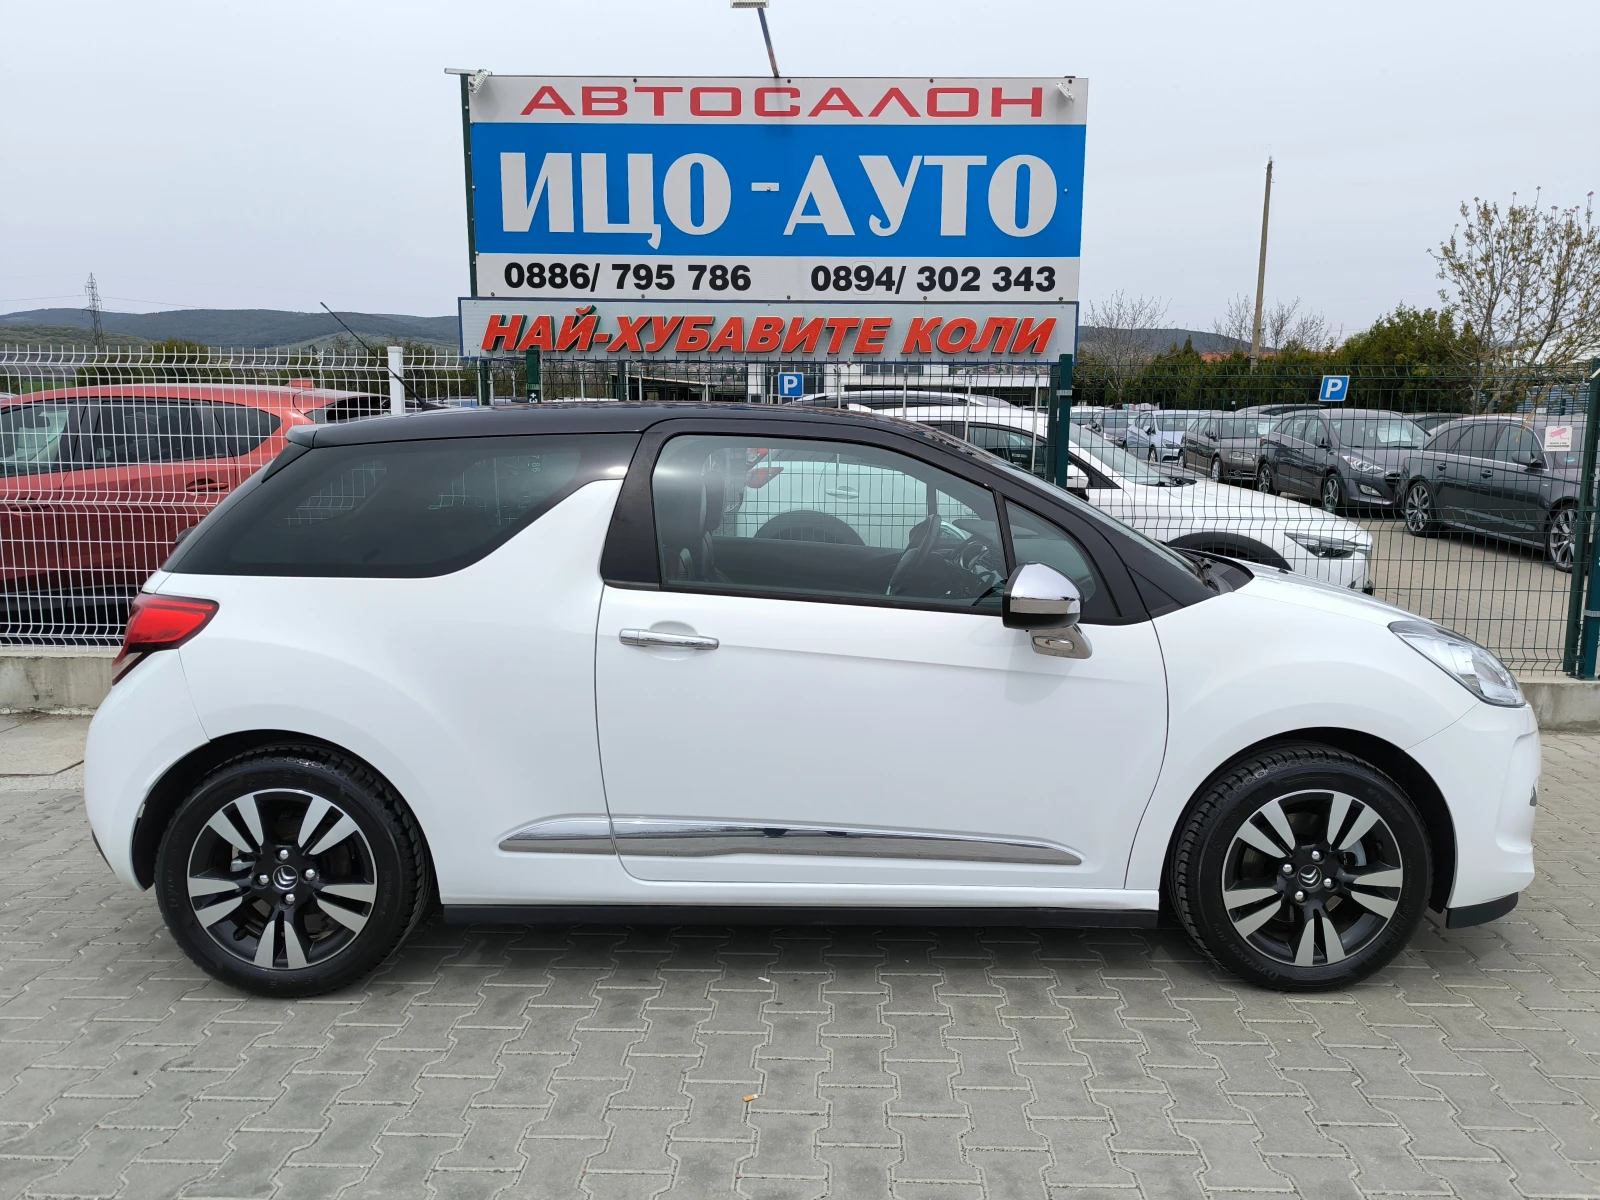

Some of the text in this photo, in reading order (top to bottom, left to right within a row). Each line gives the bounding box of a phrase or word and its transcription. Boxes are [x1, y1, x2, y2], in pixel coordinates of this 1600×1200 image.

[522, 86, 1042, 117] АВТОСАЛОН
[504, 262, 751, 292] 0886/ 795 786
[811, 265, 1056, 294] 0894/ 302 343
[481, 305, 1056, 353] НАЙ-ХУБАВИТЕ КОЛИ
[784, 376, 798, 394] P
[1325, 379, 1343, 398] P
